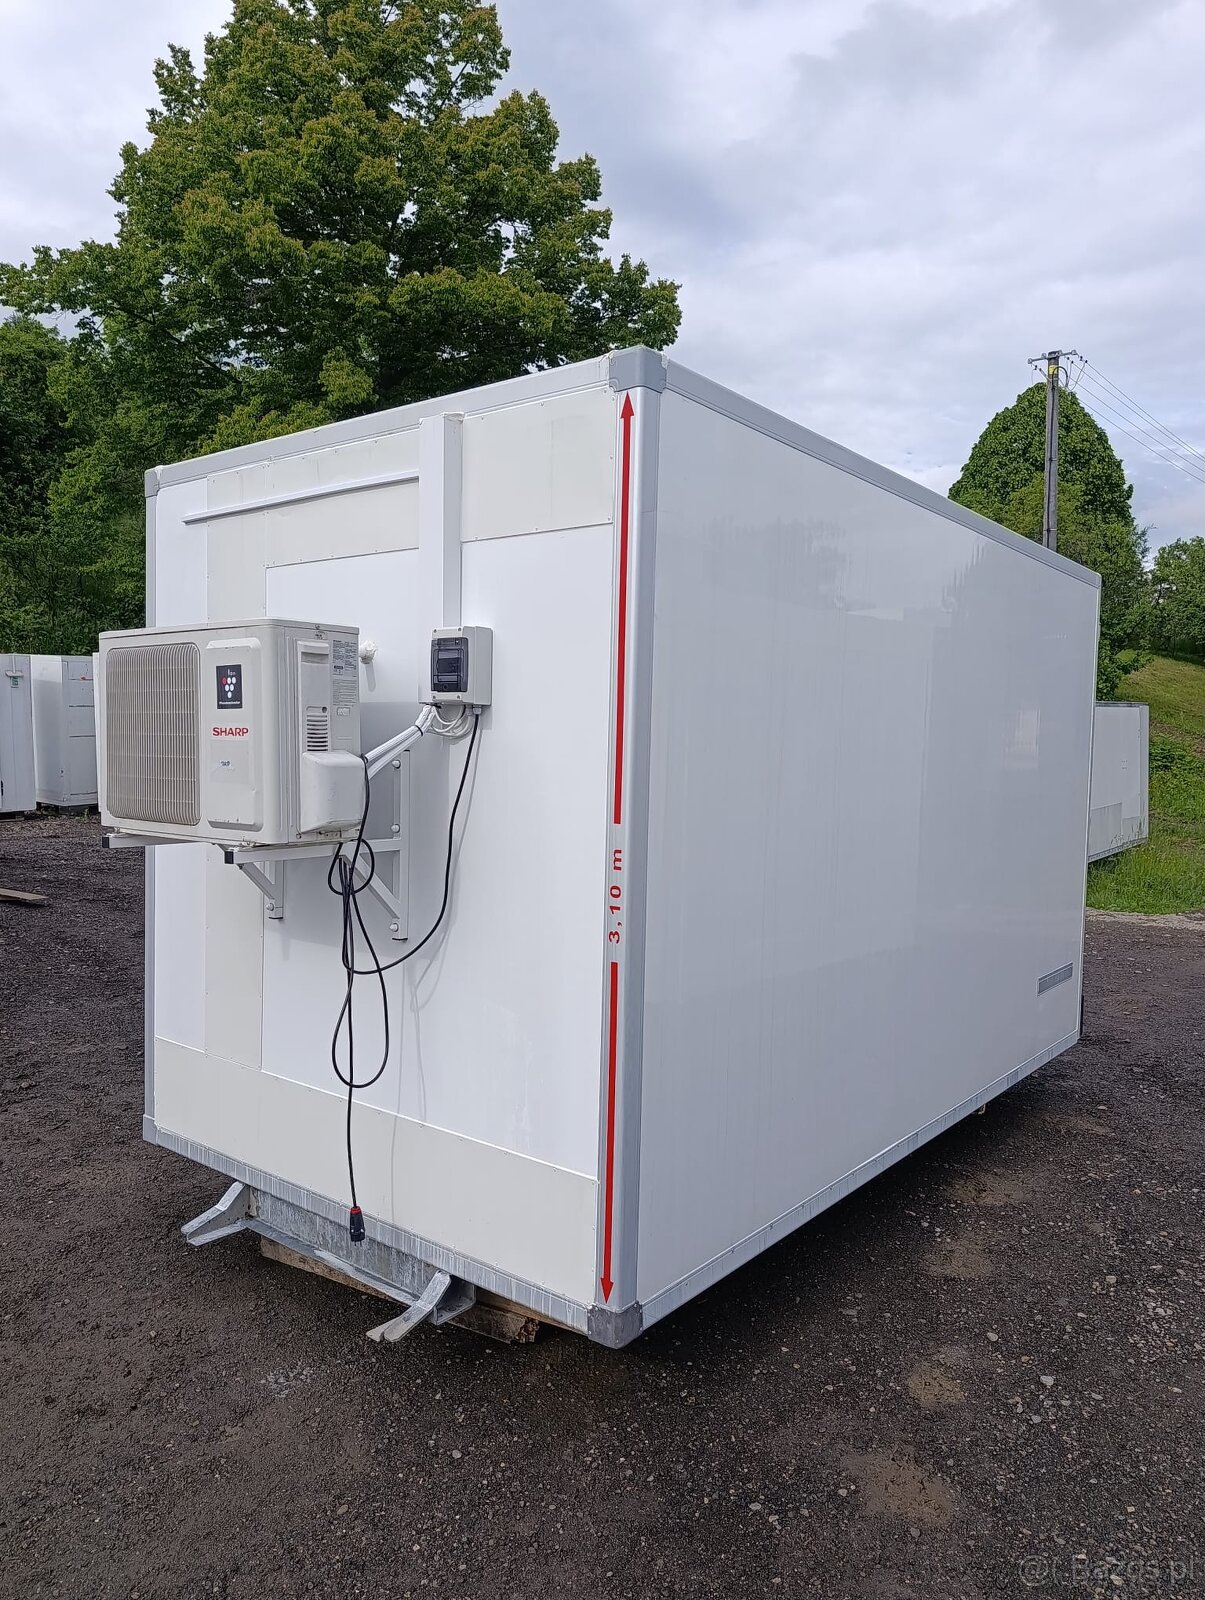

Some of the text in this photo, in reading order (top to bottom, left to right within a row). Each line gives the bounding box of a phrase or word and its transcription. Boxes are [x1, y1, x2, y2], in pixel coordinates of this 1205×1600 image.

[212, 726, 249, 737] SHARP
[608, 849, 622, 944] 3,10 m
